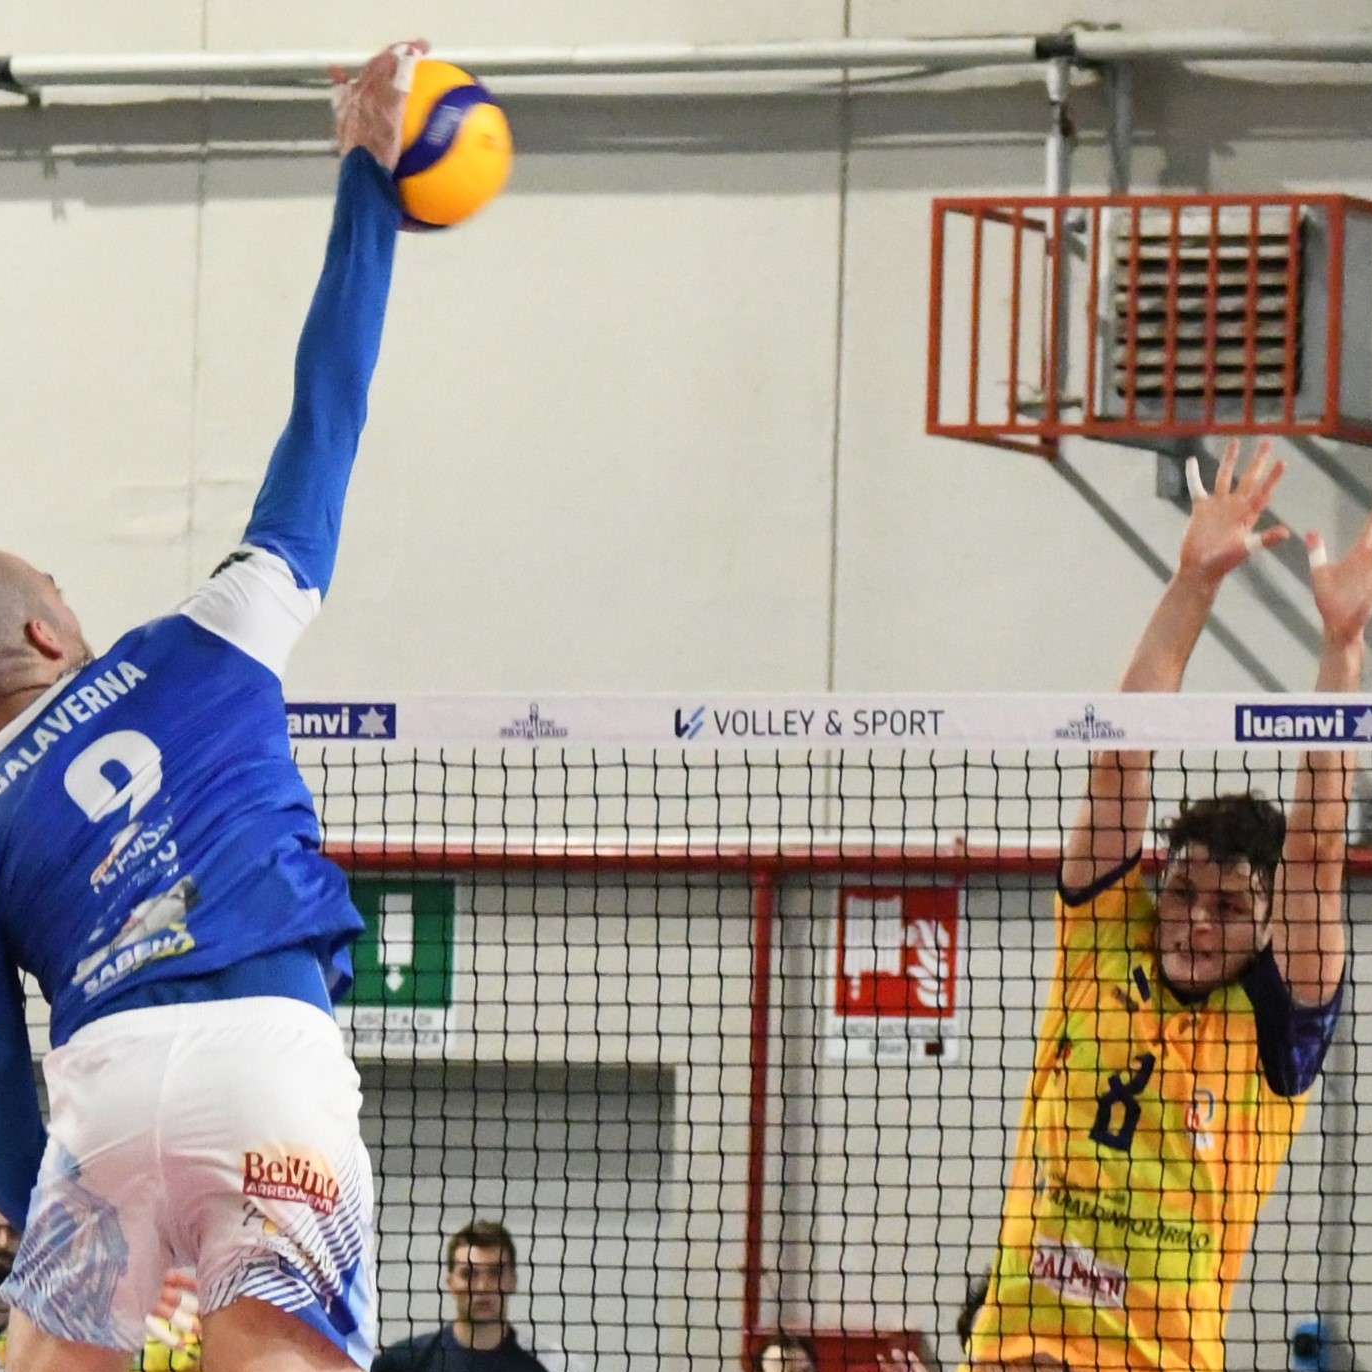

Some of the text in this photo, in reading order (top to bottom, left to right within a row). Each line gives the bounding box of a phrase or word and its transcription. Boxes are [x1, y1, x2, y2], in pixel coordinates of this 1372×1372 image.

[285, 706, 350, 736] anvi
[714, 709, 945, 737] VOLLEY & SPORT
[64, 729, 163, 824] 9
